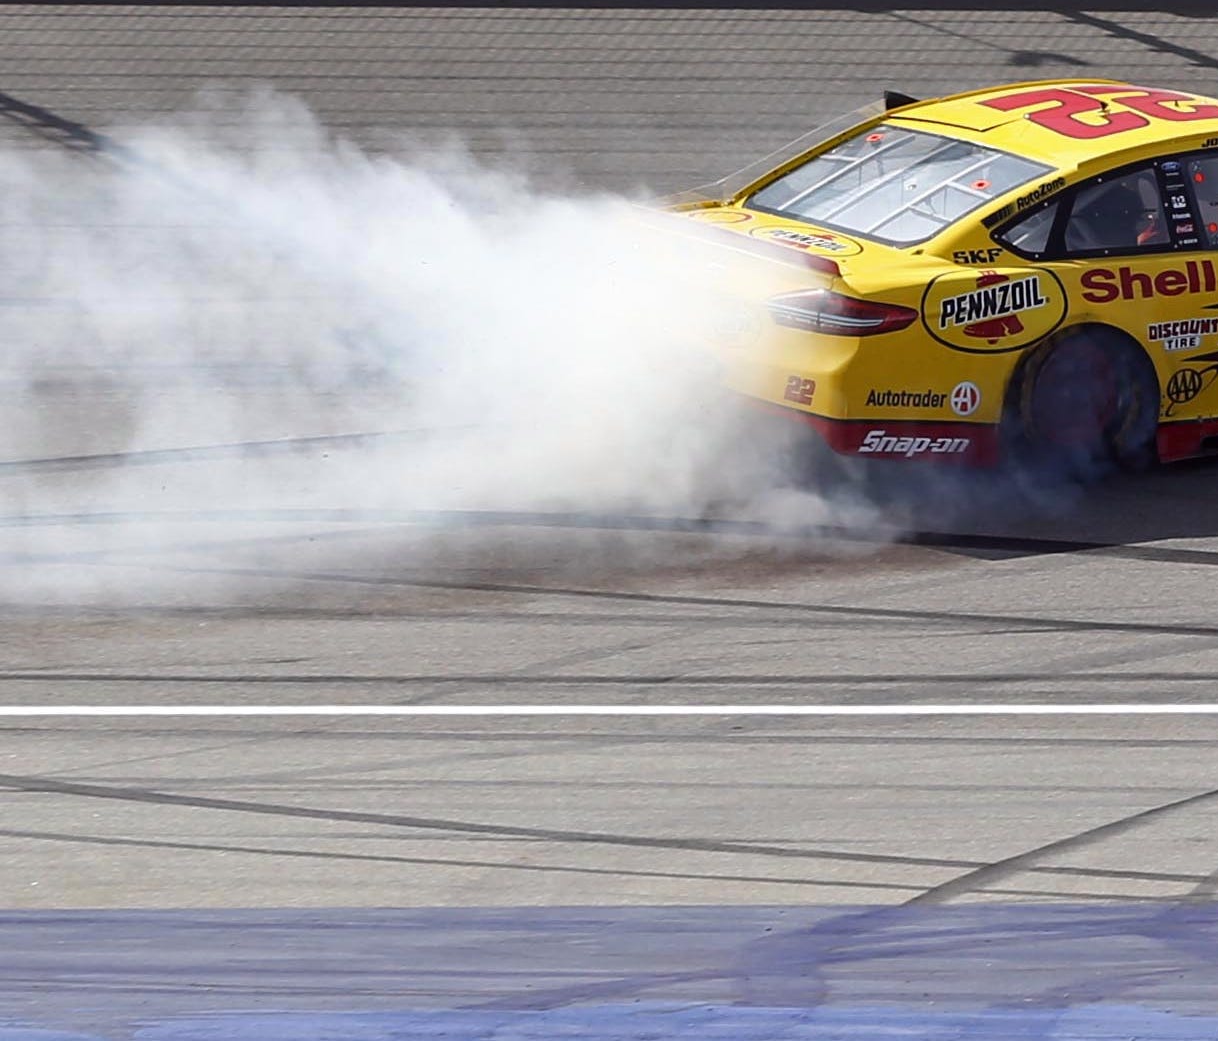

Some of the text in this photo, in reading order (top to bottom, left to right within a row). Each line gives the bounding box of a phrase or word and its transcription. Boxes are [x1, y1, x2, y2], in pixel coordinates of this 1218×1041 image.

[1017, 177, 1066, 210] AutoZone
[952, 248, 1004, 264] SKF
[1080, 260, 1217, 304] Shell
[939, 276, 1046, 329] PENNZOIL
[1148, 318, 1218, 341] DISCOUNT
[1166, 337, 1197, 350] TIRE
[784, 376, 816, 406] 22
[865, 389, 948, 408] Autotrader
[1169, 370, 1202, 401] AAA
[858, 430, 970, 457] Snap-on
